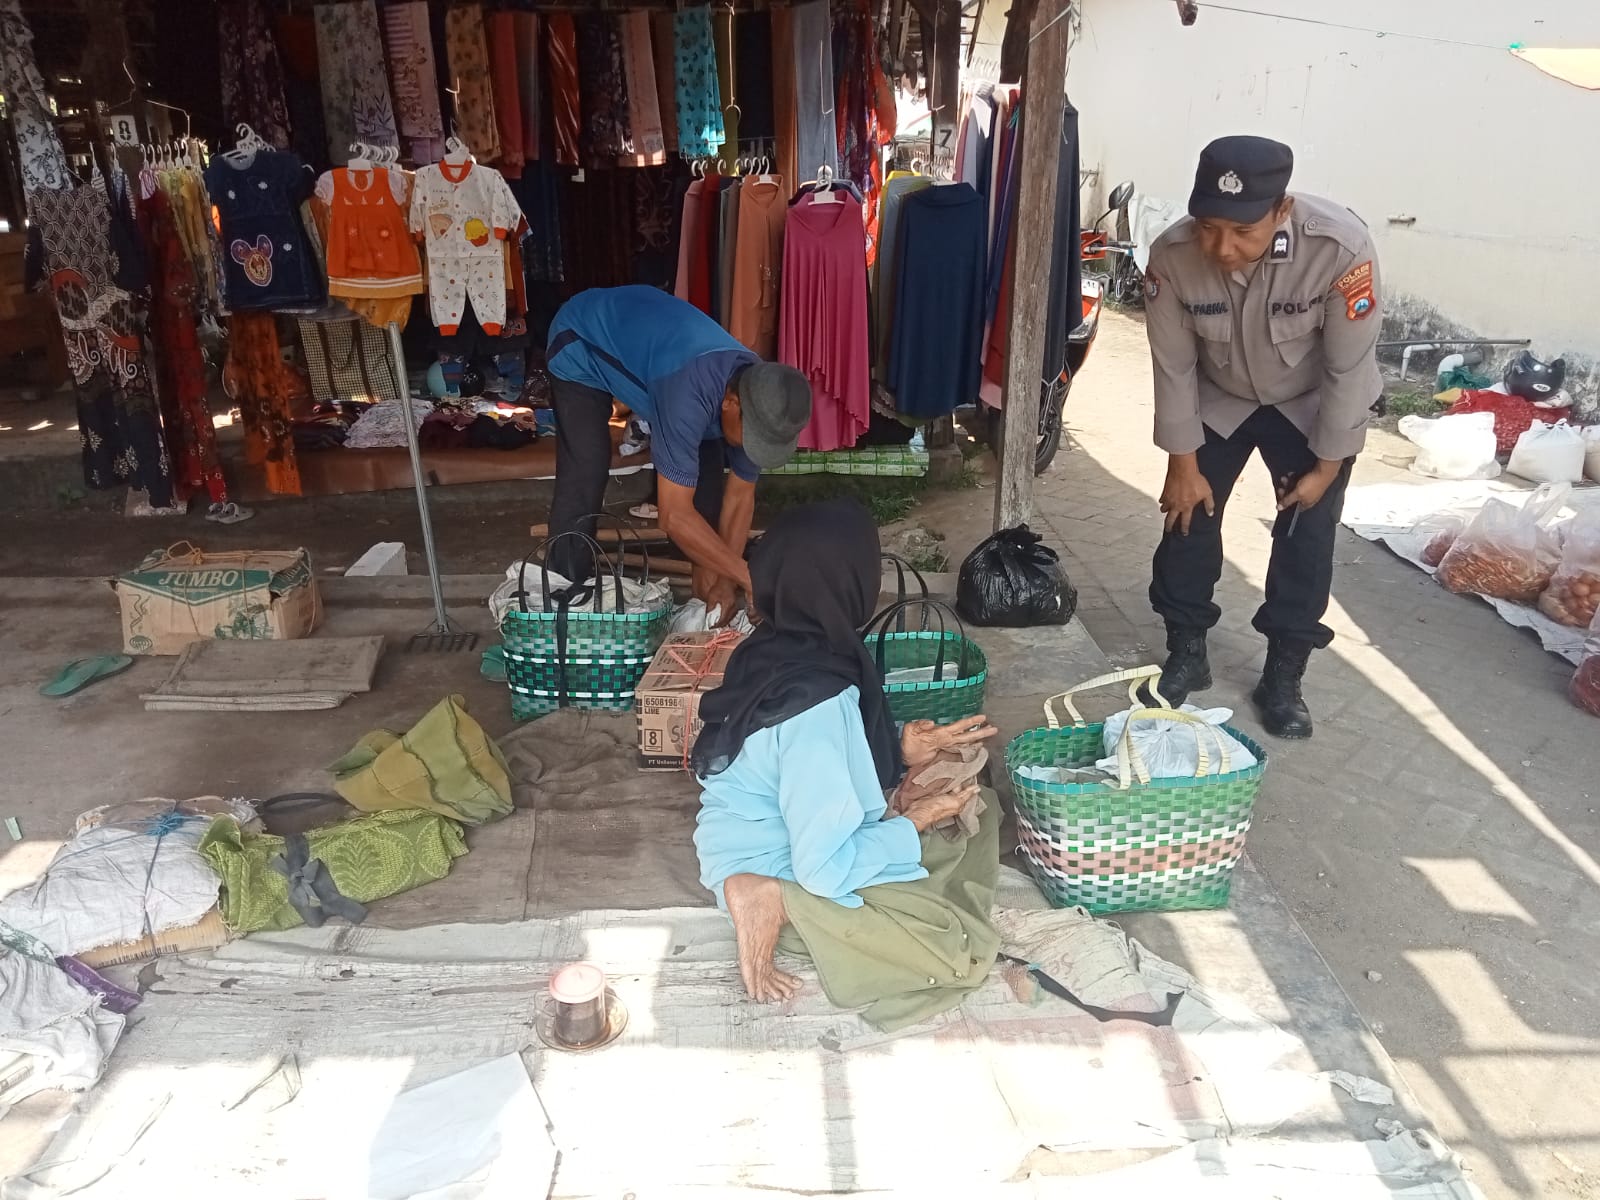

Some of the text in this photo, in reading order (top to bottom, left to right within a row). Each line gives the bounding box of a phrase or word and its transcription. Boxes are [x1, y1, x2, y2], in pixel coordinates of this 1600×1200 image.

[940, 129, 952, 147] 7
[158, 570, 239, 587] JUMBO
[649, 731, 657, 746] 8
